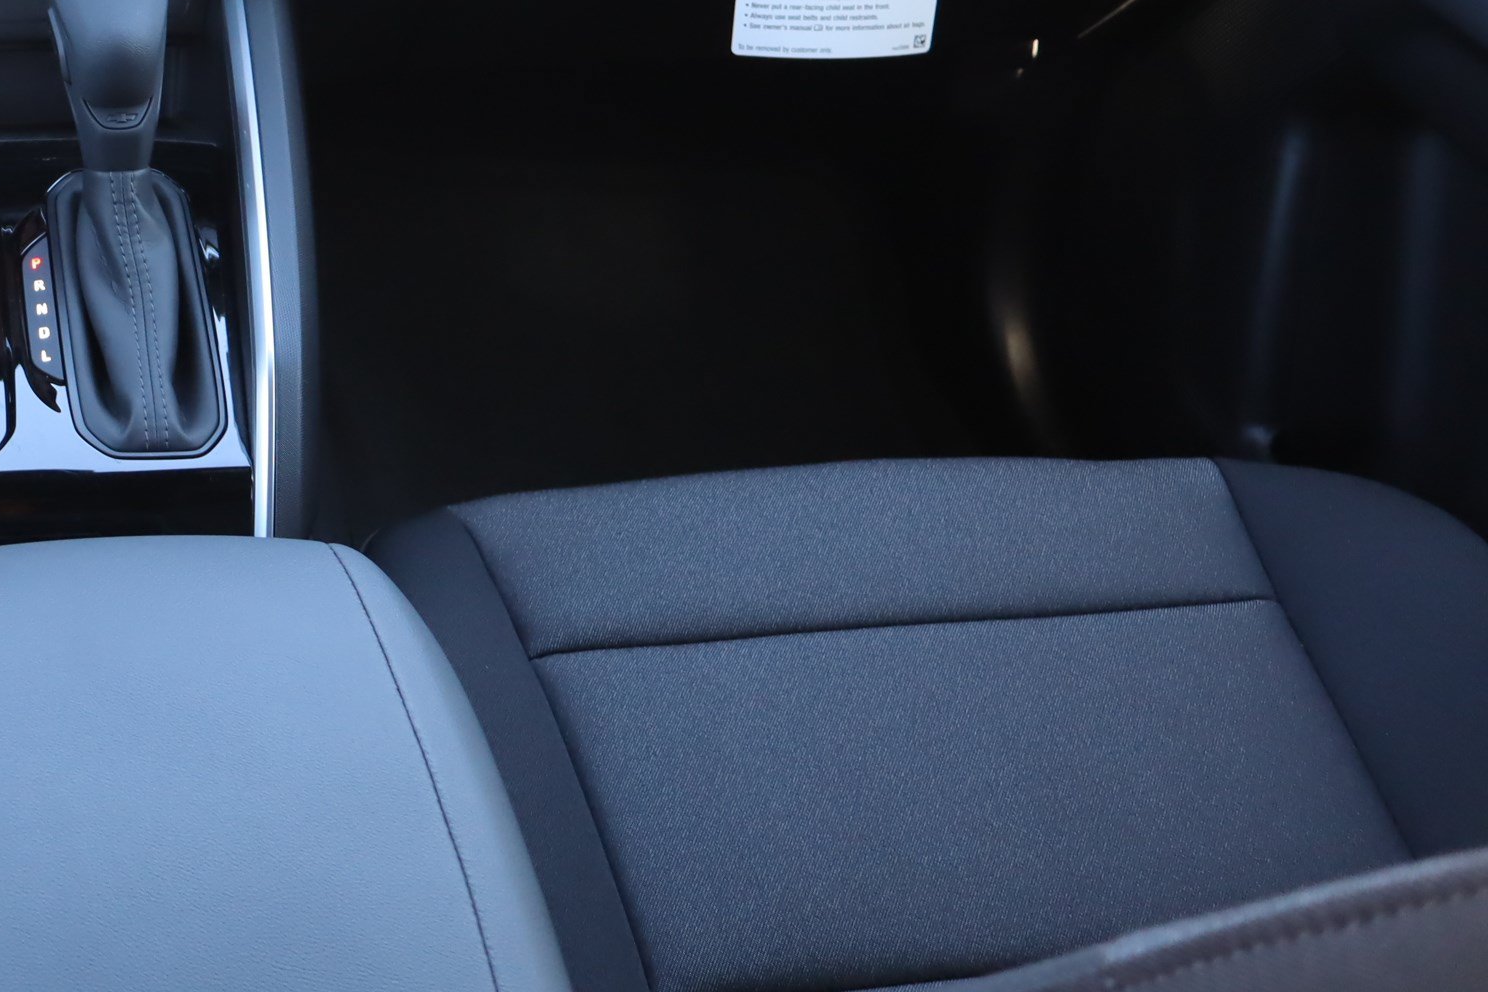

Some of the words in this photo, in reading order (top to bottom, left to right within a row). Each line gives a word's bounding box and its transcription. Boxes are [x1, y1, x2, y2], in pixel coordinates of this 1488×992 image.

[31, 257, 41, 269] P
[34, 279, 46, 292] R
[36, 302, 48, 315] N
[38, 326, 50, 339] D
[41, 350, 52, 363] L
